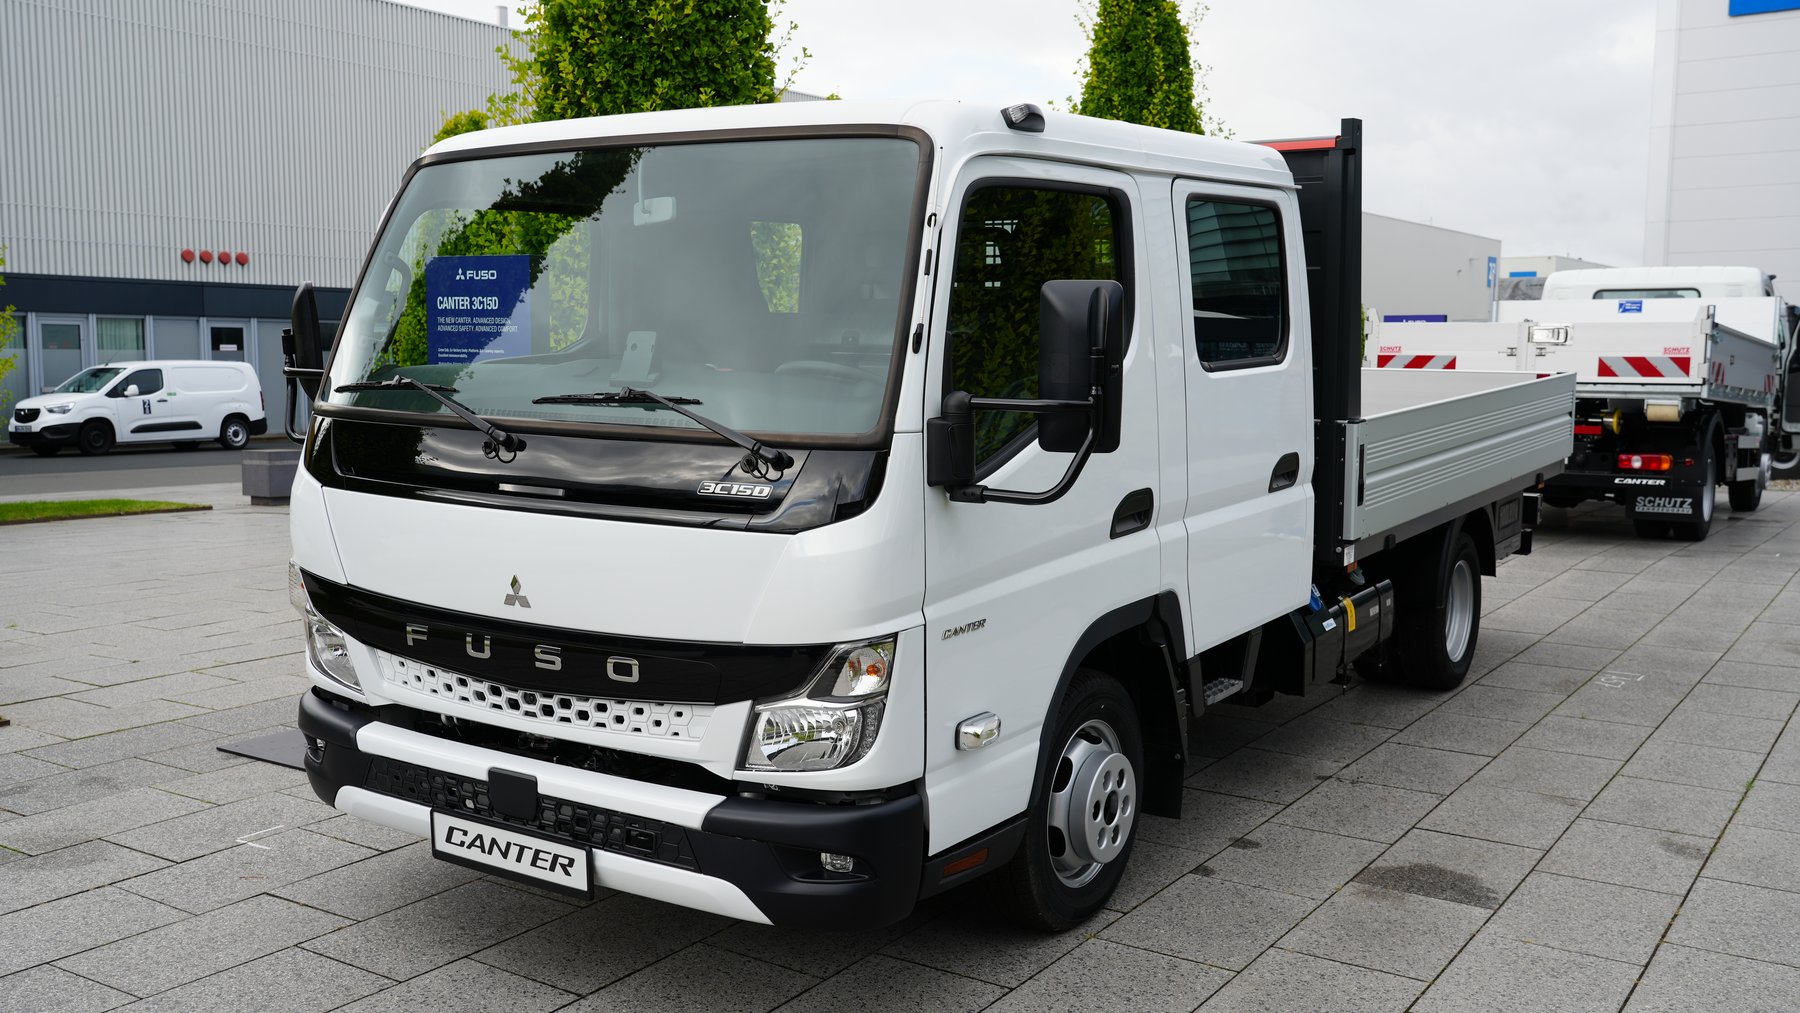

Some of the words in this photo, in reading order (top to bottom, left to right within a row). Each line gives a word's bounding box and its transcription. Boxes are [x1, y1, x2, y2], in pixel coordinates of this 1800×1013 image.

[466, 270, 497, 280] FUSO
[437, 296, 470, 310] CANTER
[471, 296, 499, 310] 3C15D
[437, 316, 445, 324] THE
[446, 316, 454, 324] NEW
[473, 316, 494, 324] ADVANCED
[475, 325, 497, 333] ADVANCED
[1614, 477, 1666, 486] CANTER
[700, 482, 772, 498] 3C15D
[1635, 496, 1693, 509] SCHUTZ
[941, 618, 987, 641] CANTER
[405, 622, 640, 683] FUSO
[445, 825, 576, 877] CANTER
